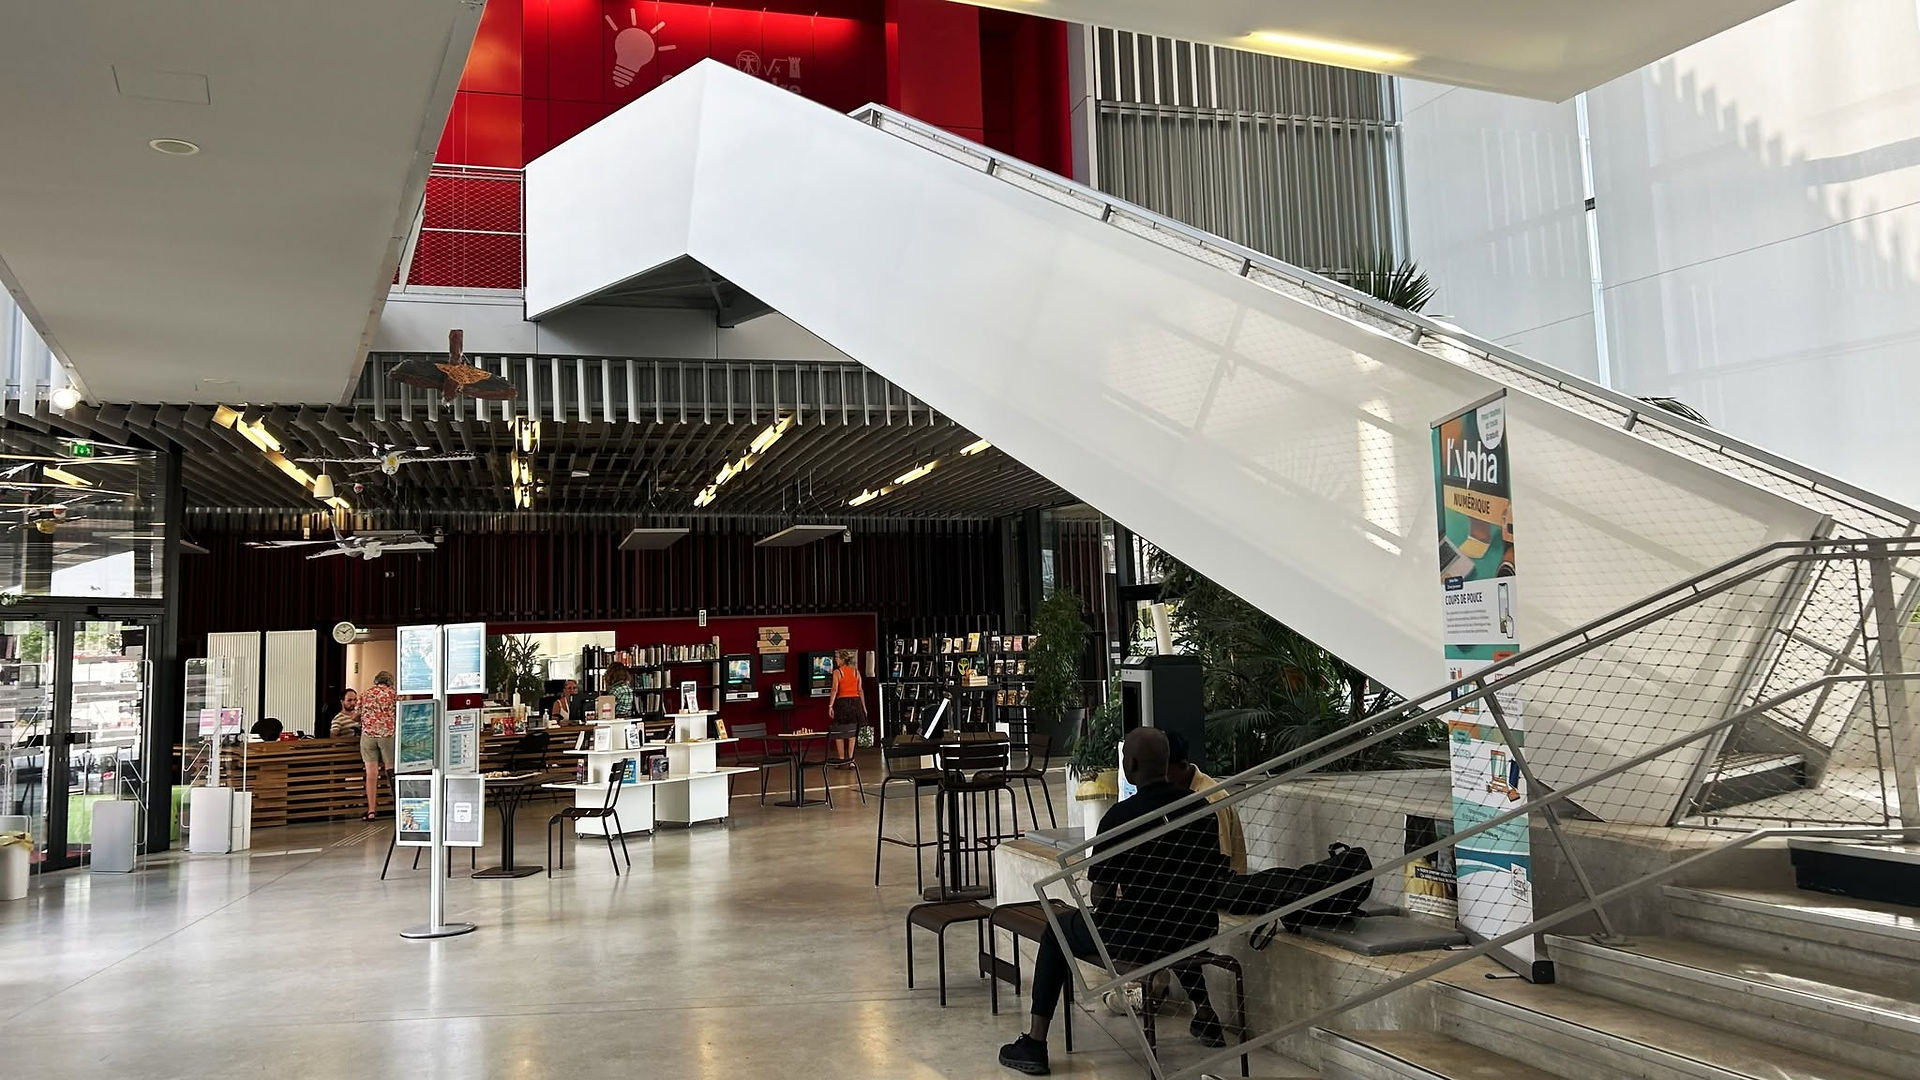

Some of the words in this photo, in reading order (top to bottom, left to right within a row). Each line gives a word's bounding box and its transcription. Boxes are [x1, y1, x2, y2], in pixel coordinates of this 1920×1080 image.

[1453, 493, 1491, 514] NUMÉRIQUE
[1445, 594, 1460, 605] COUPS
[1460, 593, 1467, 604] DE
[1467, 592, 1483, 603] POUCE
